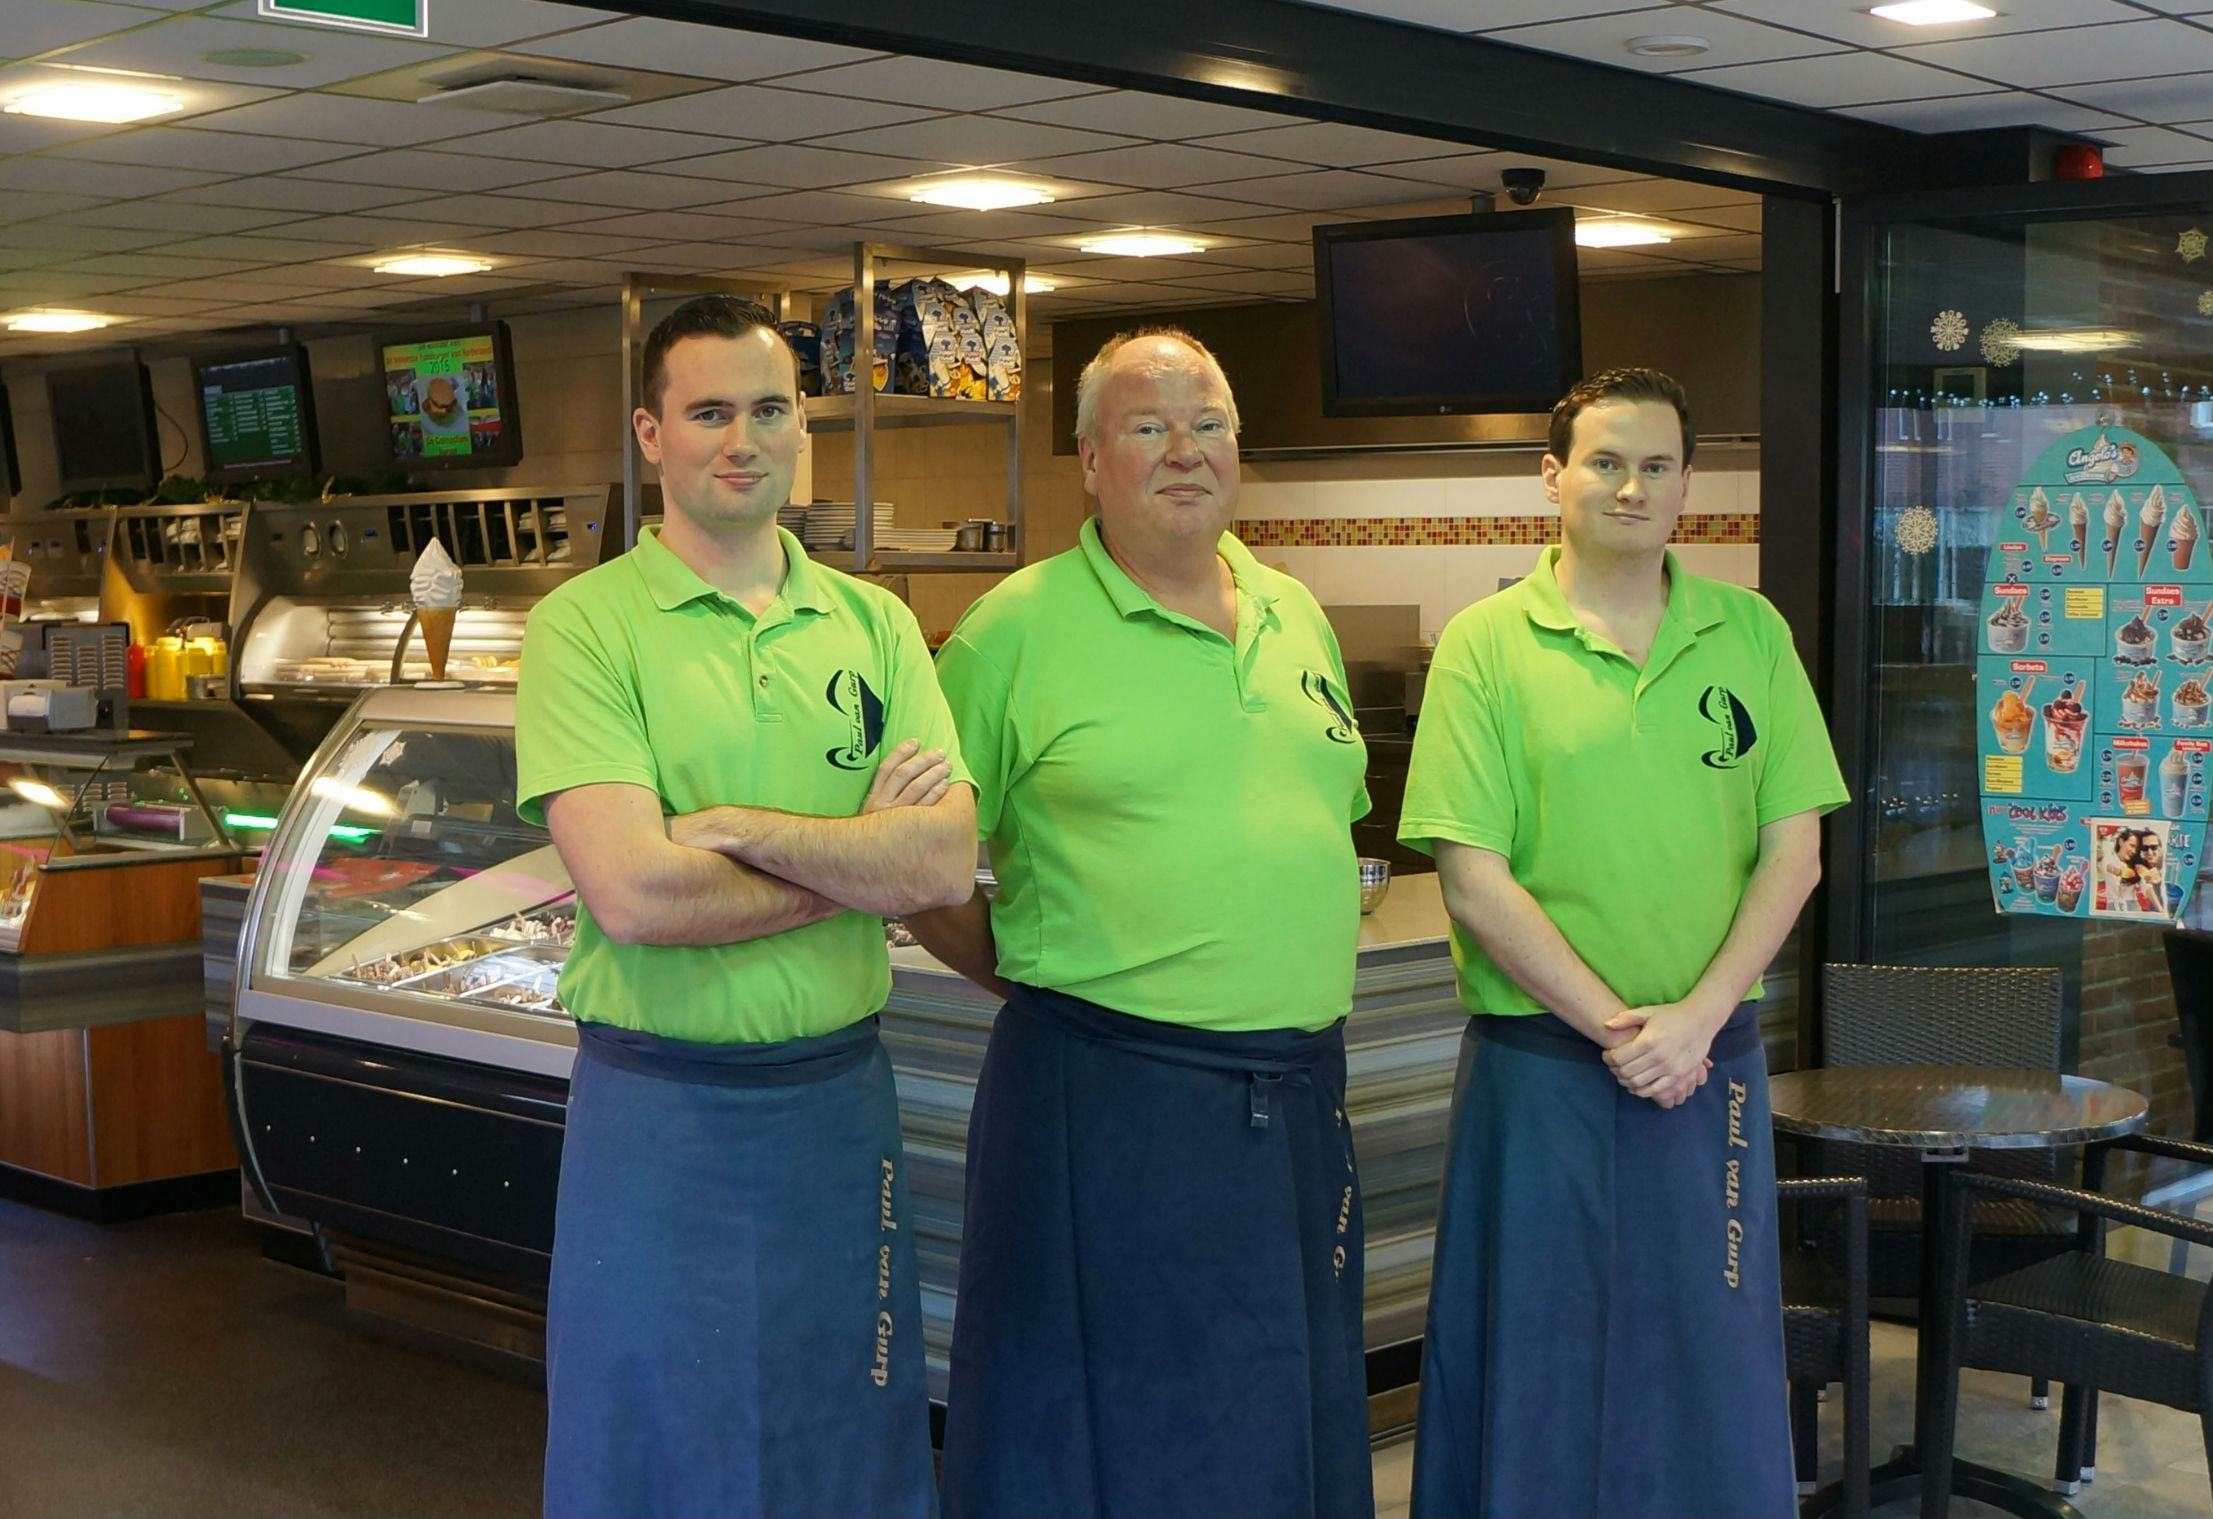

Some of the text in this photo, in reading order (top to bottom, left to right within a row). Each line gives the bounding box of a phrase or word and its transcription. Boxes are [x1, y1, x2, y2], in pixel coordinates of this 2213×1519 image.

[1994, 586, 2028, 596] Sundaes
[2145, 586, 2180, 596] Sundaes
[2151, 596, 2175, 605] Extra
[847, 670, 863, 755] Paul van Gurp
[1724, 731, 1735, 757] Paul
[1723, 1077, 1748, 1289] Paul van Gurp
[870, 1157, 897, 1387] Paul van Gurp
